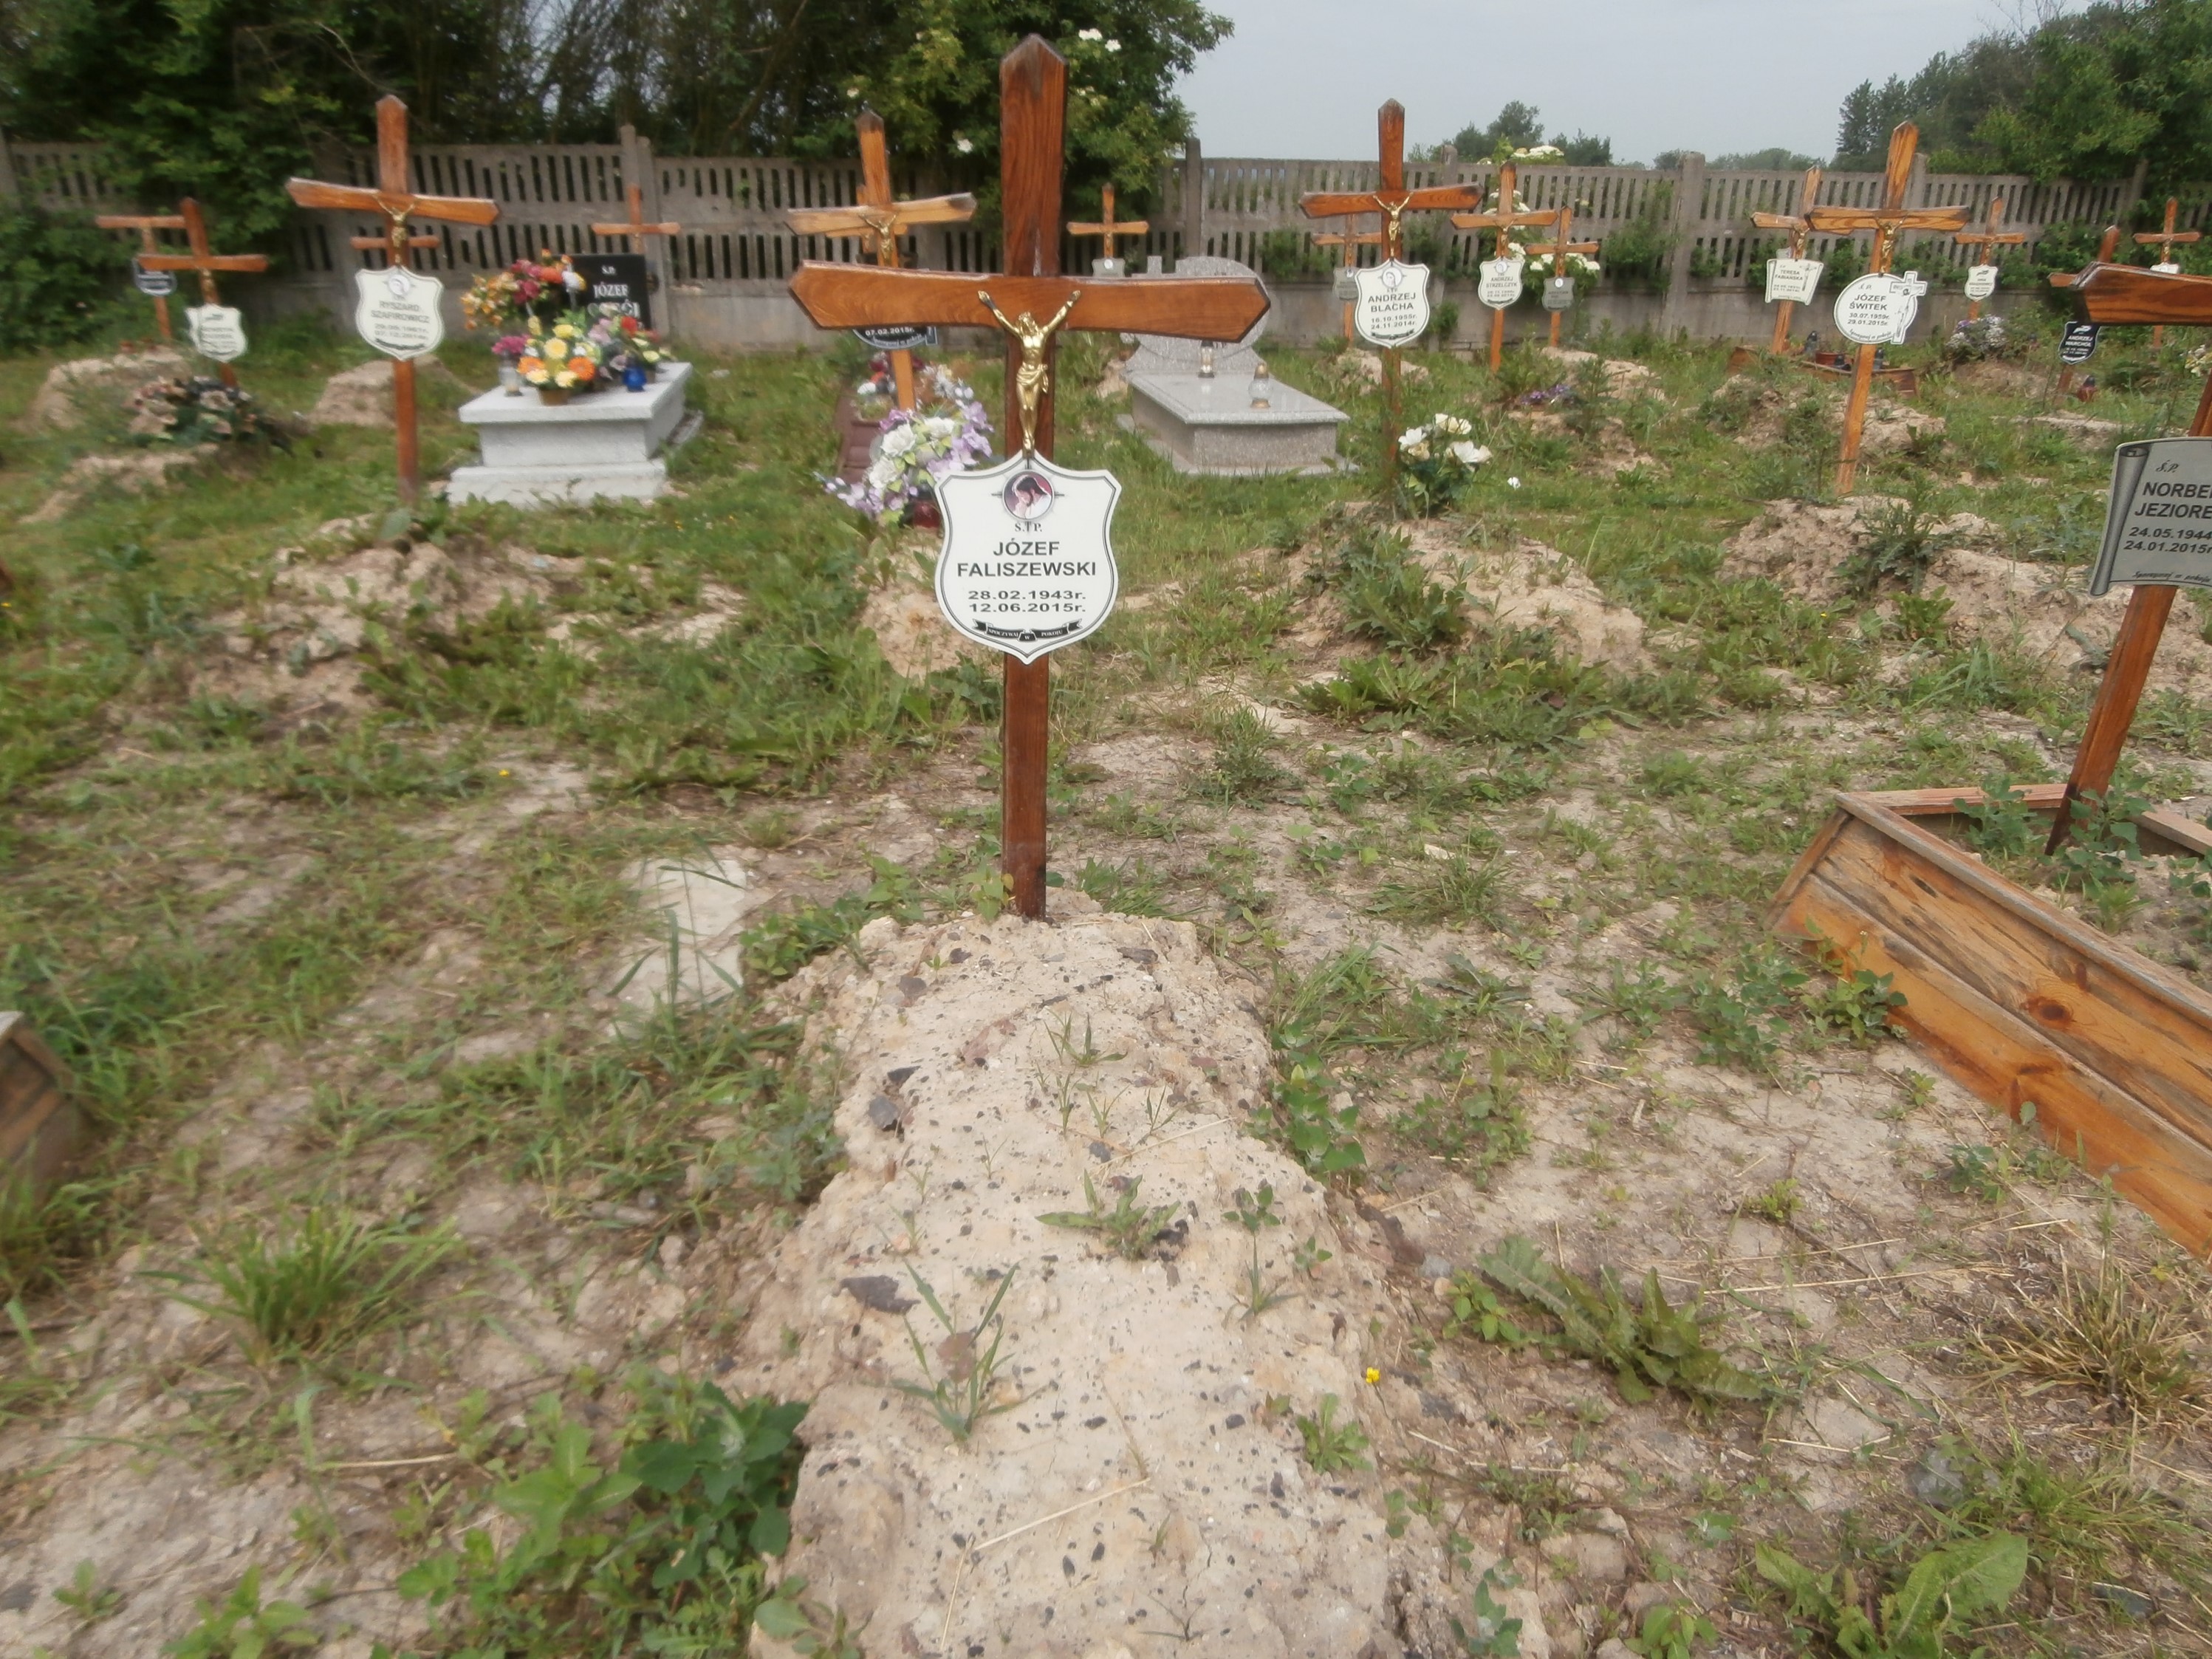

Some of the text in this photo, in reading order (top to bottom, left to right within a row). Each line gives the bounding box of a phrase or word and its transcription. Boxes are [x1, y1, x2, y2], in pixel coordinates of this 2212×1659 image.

[593, 281, 629, 298] JÓZEF
[1368, 293, 1417, 304] ANDRZEJ
[1855, 293, 1886, 302] JÓZEF
[380, 301, 420, 312] RYSZARD
[1849, 301, 1887, 310] ŚWITEK
[865, 326, 915, 337] 07.02.2015r.
[2143, 482, 2212, 499] NORBE
[993, 538, 1060, 556] JÓZEF
[957, 561, 1096, 577] FALISZEWSKI
[968, 590, 1086, 601] 28.02.1943r.
[968, 603, 1086, 613] 12.06.2015r.
[1041, 629, 1064, 637] POKOJU
